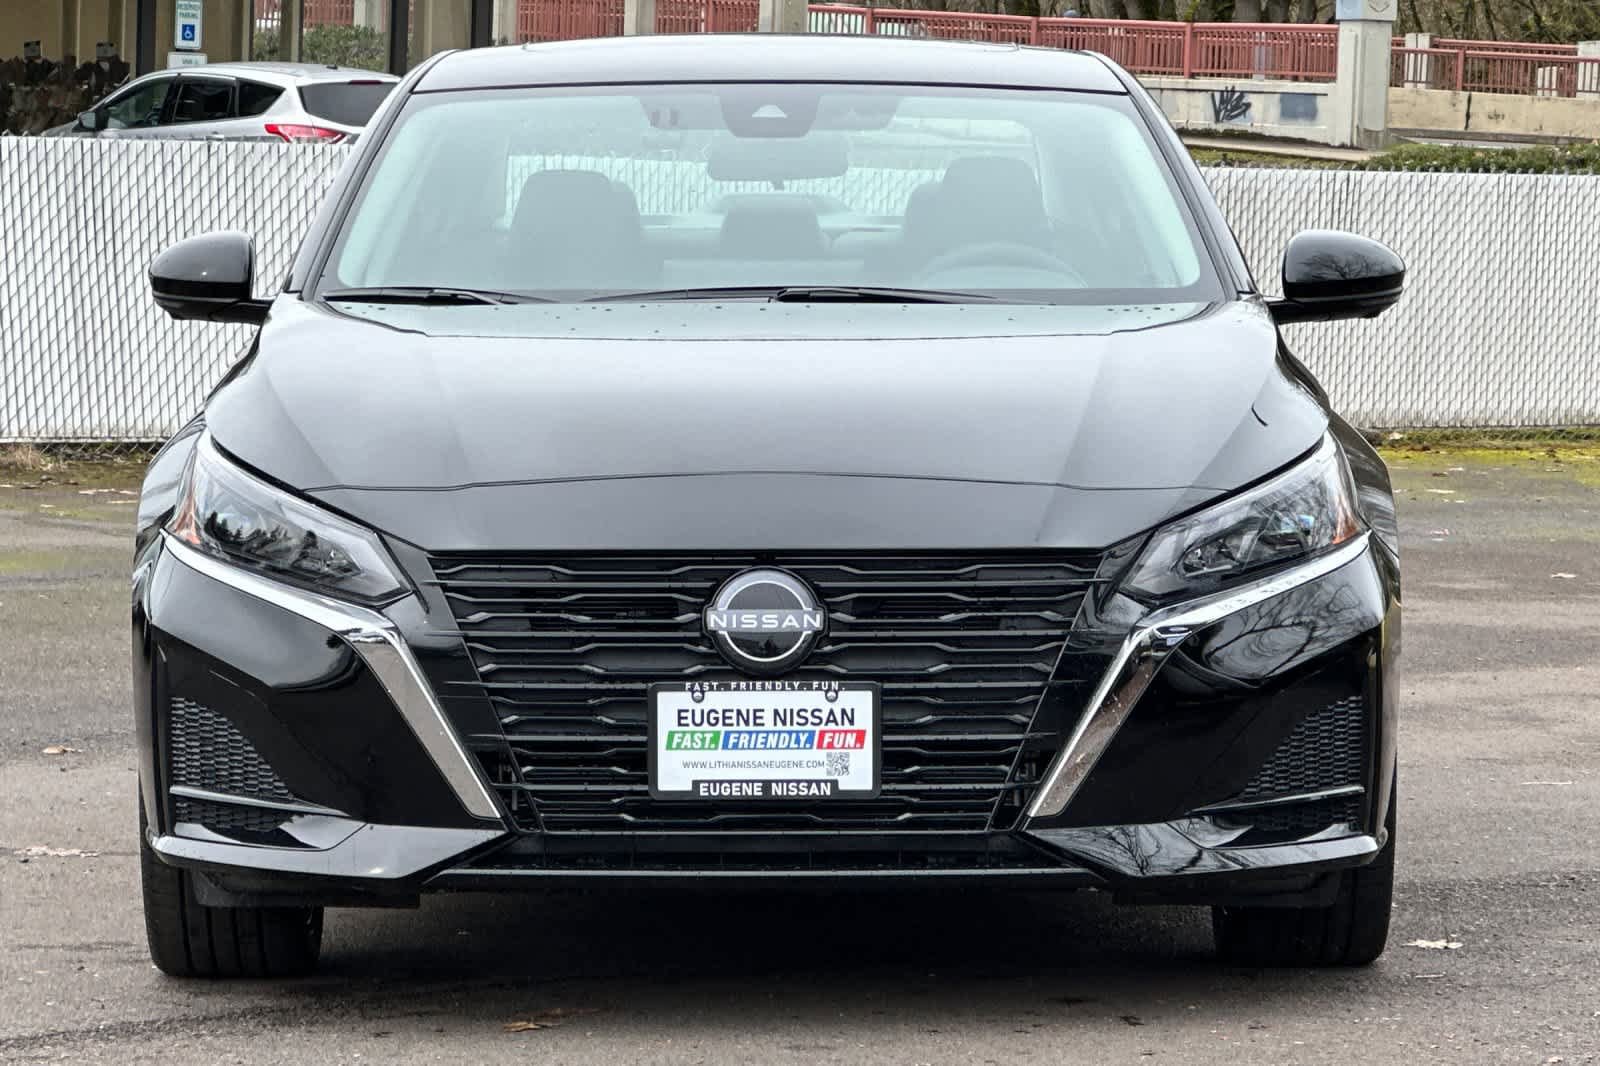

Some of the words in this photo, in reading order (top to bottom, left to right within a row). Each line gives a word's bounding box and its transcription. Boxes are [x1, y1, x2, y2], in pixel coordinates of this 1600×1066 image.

[710, 614, 820, 628] NISSAN
[685, 682, 724, 691] FAST.
[730, 682, 807, 691] FRIENDLY.
[677, 708, 765, 727] EUGENE
[773, 707, 855, 726] NISSAN
[672, 732, 715, 749] FAST.
[727, 732, 811, 748] FRIENDLY.
[822, 732, 861, 748] FUN.
[682, 760, 825, 769] WWW.LITHIANISSANEUGENE.COM
[699, 783, 763, 796] EUGENE
[771, 782, 831, 796] NISSAN
